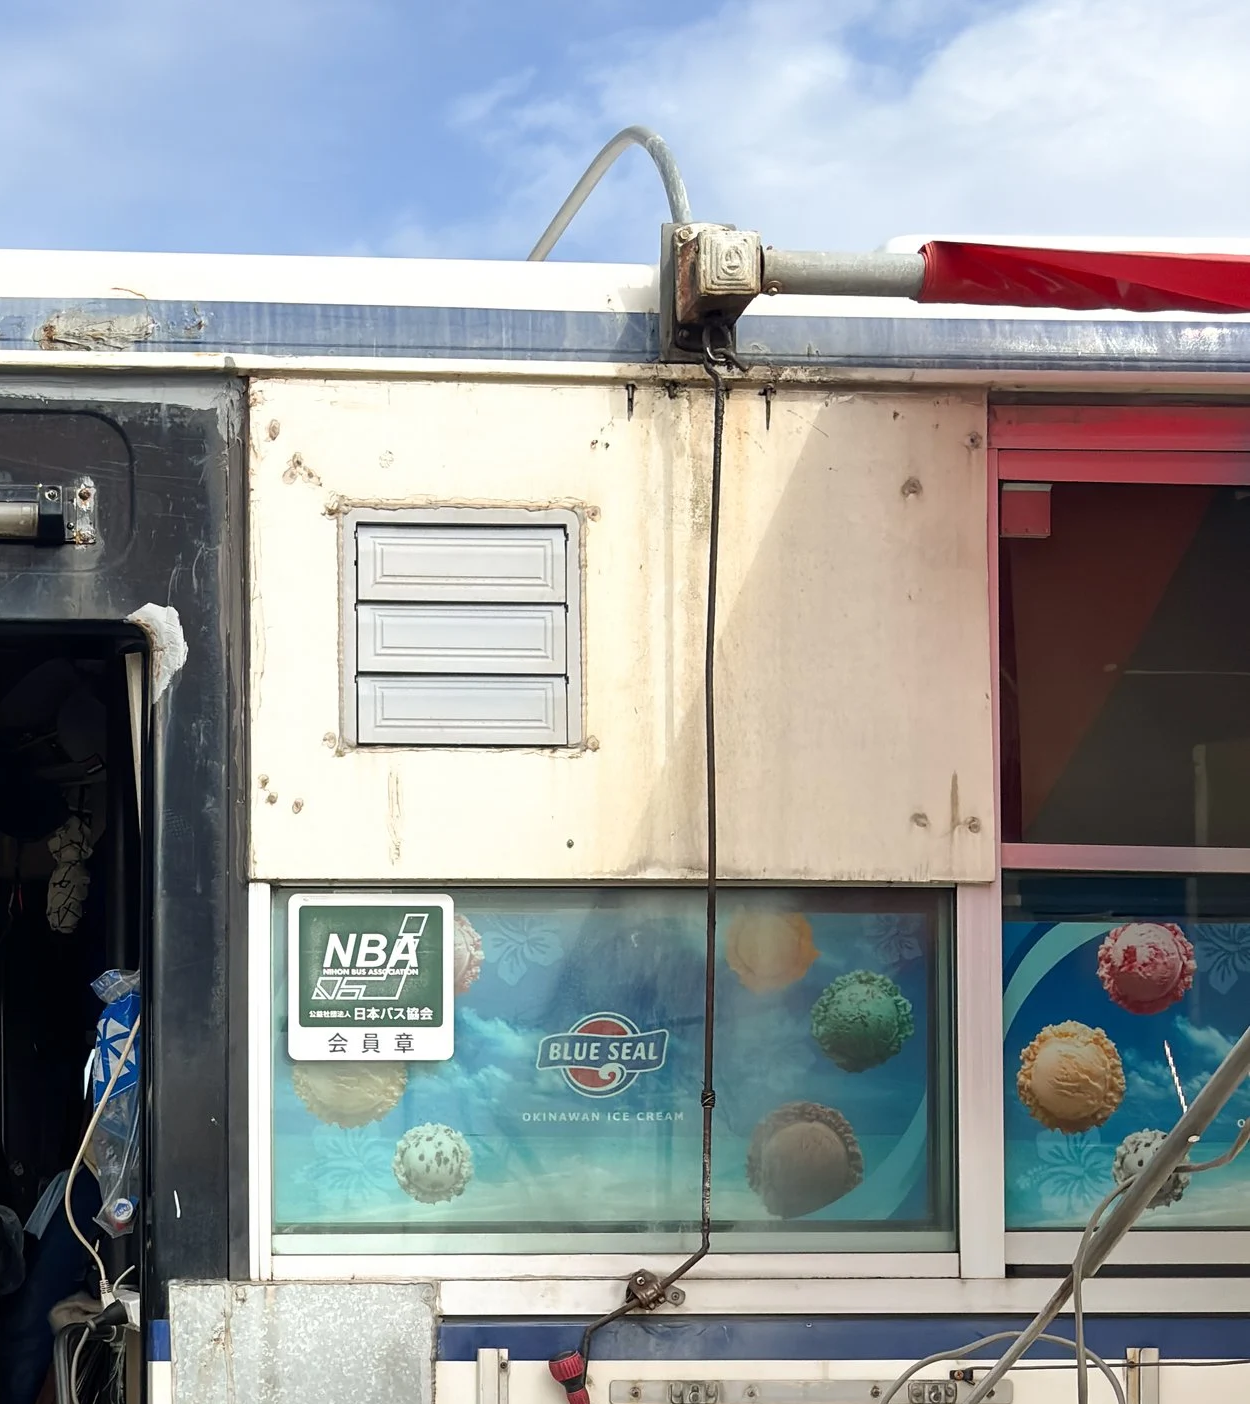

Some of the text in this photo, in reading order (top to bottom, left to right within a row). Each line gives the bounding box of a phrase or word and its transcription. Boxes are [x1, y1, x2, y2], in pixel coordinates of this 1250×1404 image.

[323, 933, 419, 968] NBA
[322, 968, 419, 976] NIHON BUS ASSOCIATION
[354, 1007, 434, 1021] 日本バス協会
[327, 1032, 415, 1054] 会員章
[549, 1042, 659, 1061] BLUE SEAL
[522, 1111, 685, 1122] OKINAWAN ICE CREAM
